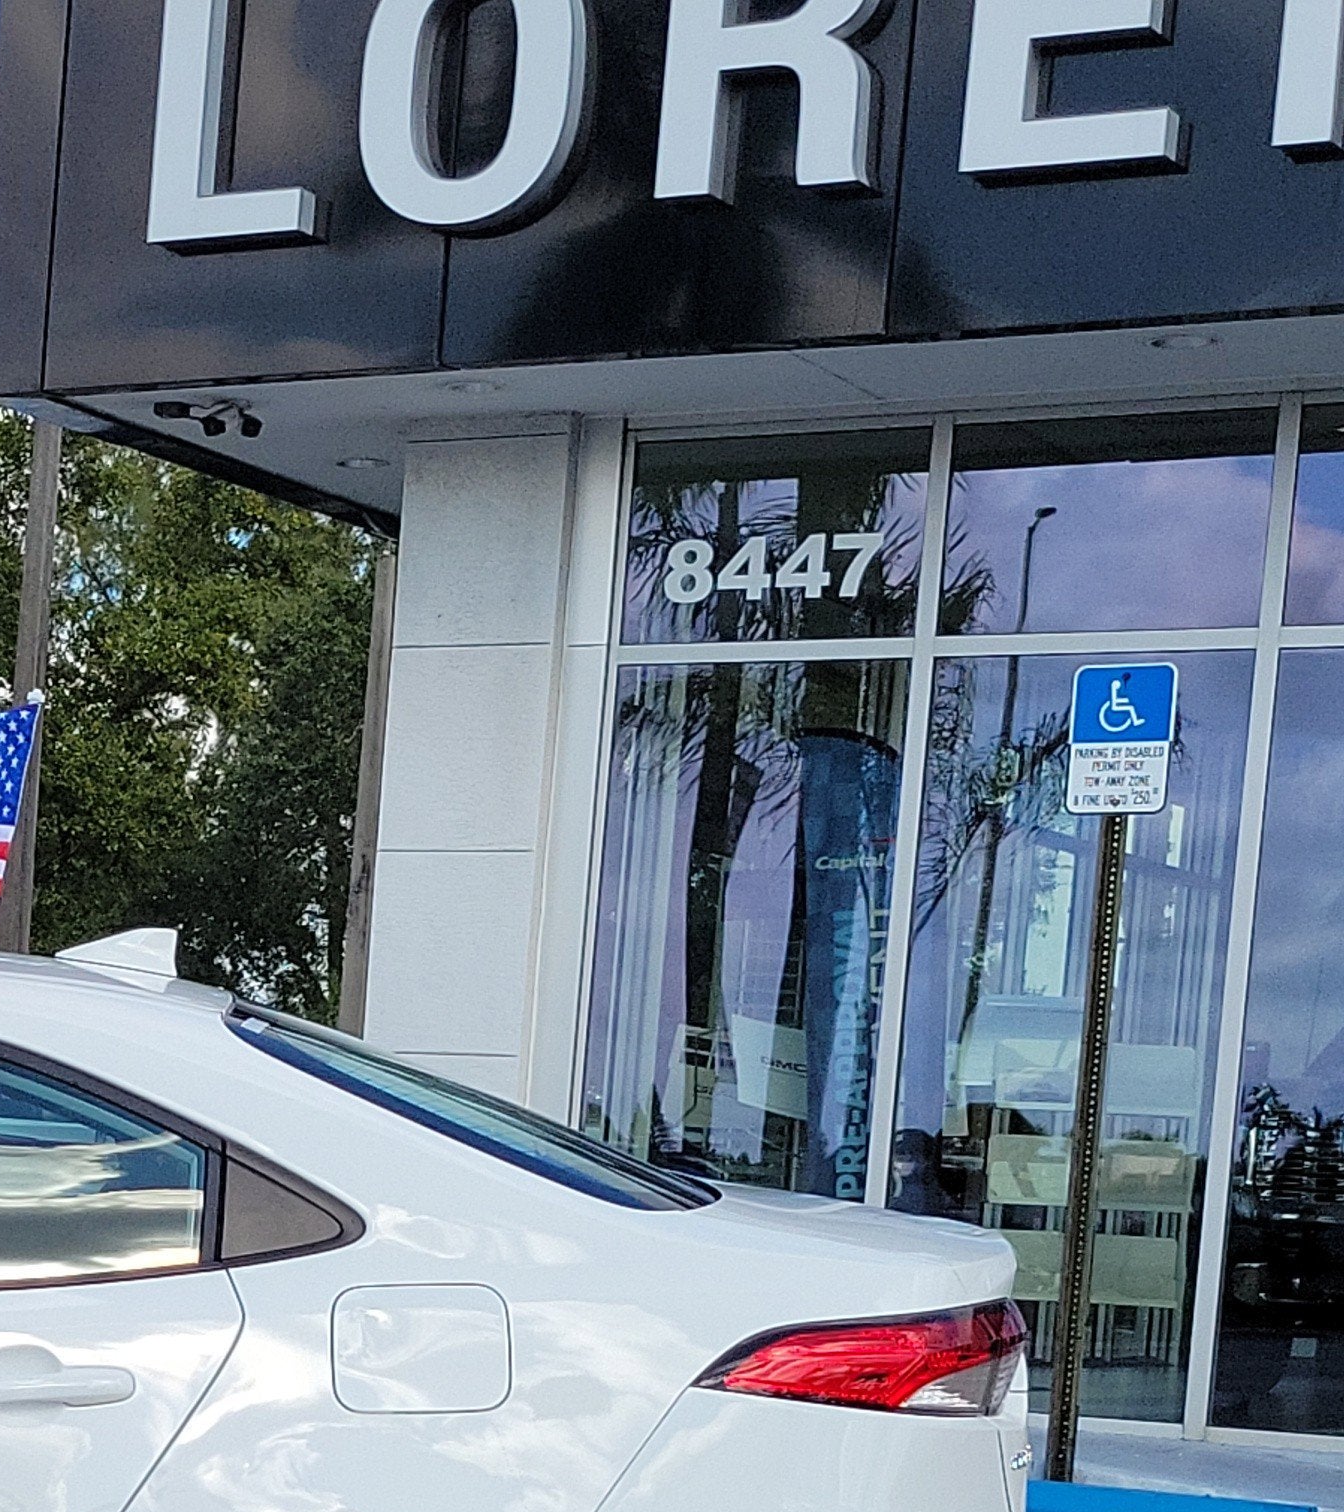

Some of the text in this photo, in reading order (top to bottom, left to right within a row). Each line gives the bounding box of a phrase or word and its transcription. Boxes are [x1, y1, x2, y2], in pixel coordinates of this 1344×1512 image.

[664, 533, 884, 603] 8447
[1075, 746, 1164, 759] PARKING BY DISABLED
[1092, 760, 1145, 771] PERMIT ONLY
[1129, 775, 1151, 786] ZONE
[1083, 794, 1100, 806] FINE
